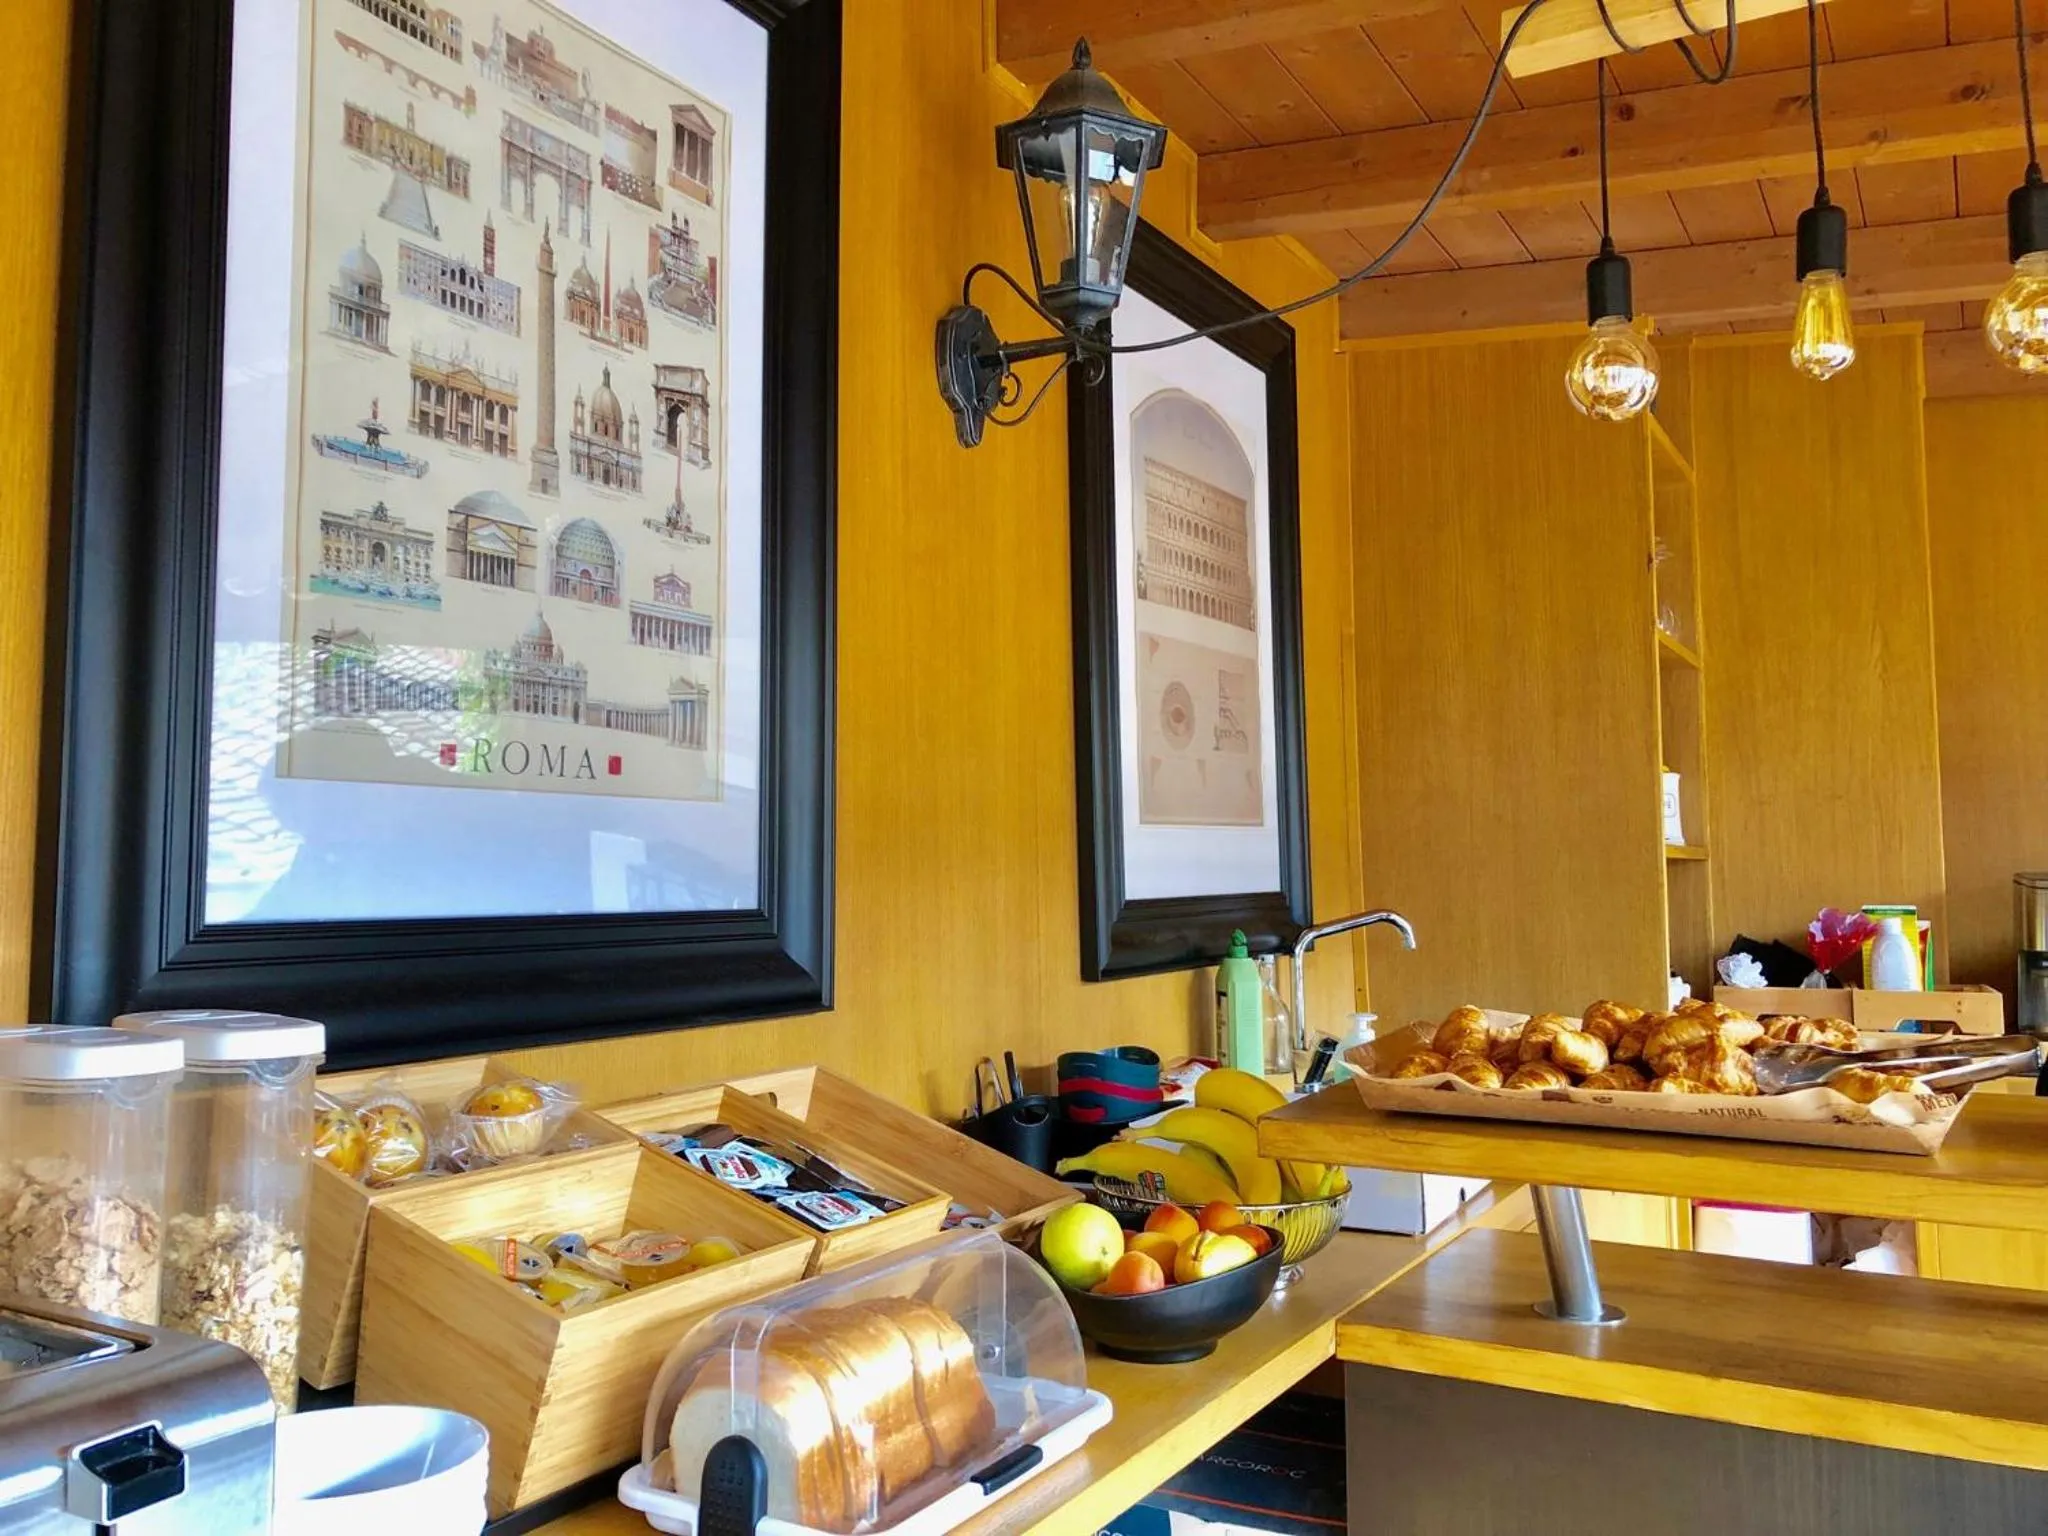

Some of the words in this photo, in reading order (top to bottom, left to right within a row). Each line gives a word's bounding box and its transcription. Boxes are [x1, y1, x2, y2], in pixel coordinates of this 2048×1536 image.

[470, 738, 597, 780] ROMA
[1698, 1107, 1768, 1120] NATURAL
[1199, 1453, 1308, 1479] RCOROC
